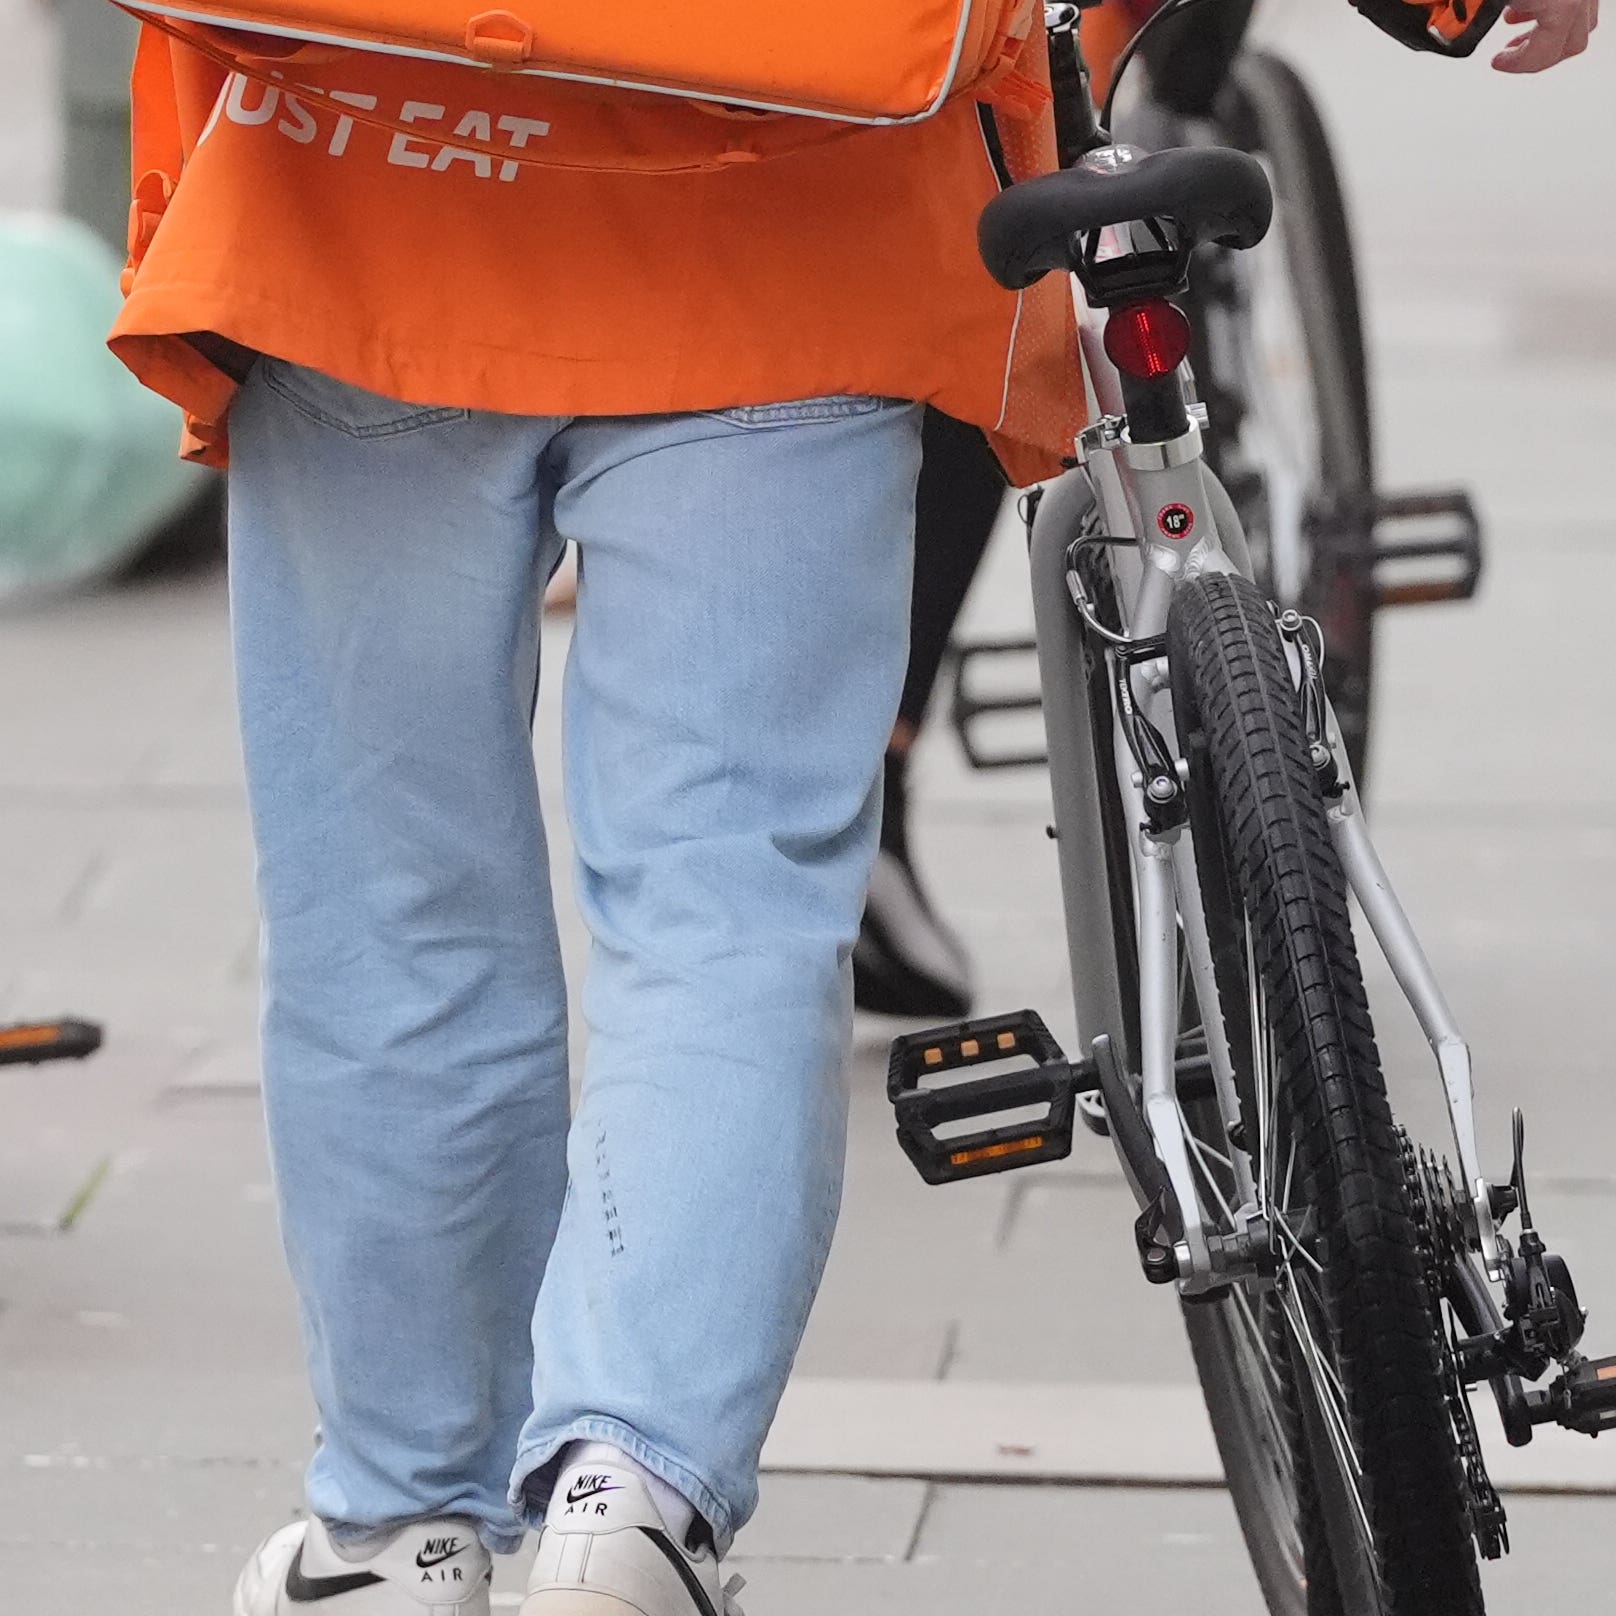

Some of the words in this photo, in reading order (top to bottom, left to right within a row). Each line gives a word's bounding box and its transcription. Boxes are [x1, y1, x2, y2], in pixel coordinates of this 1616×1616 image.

[387, 100, 551, 182] EAT
[573, 1474, 613, 1491] NIKE
[565, 1502, 608, 1516] AIR
[423, 1537, 459, 1555] NIKE
[420, 1567, 463, 1582] AIR
